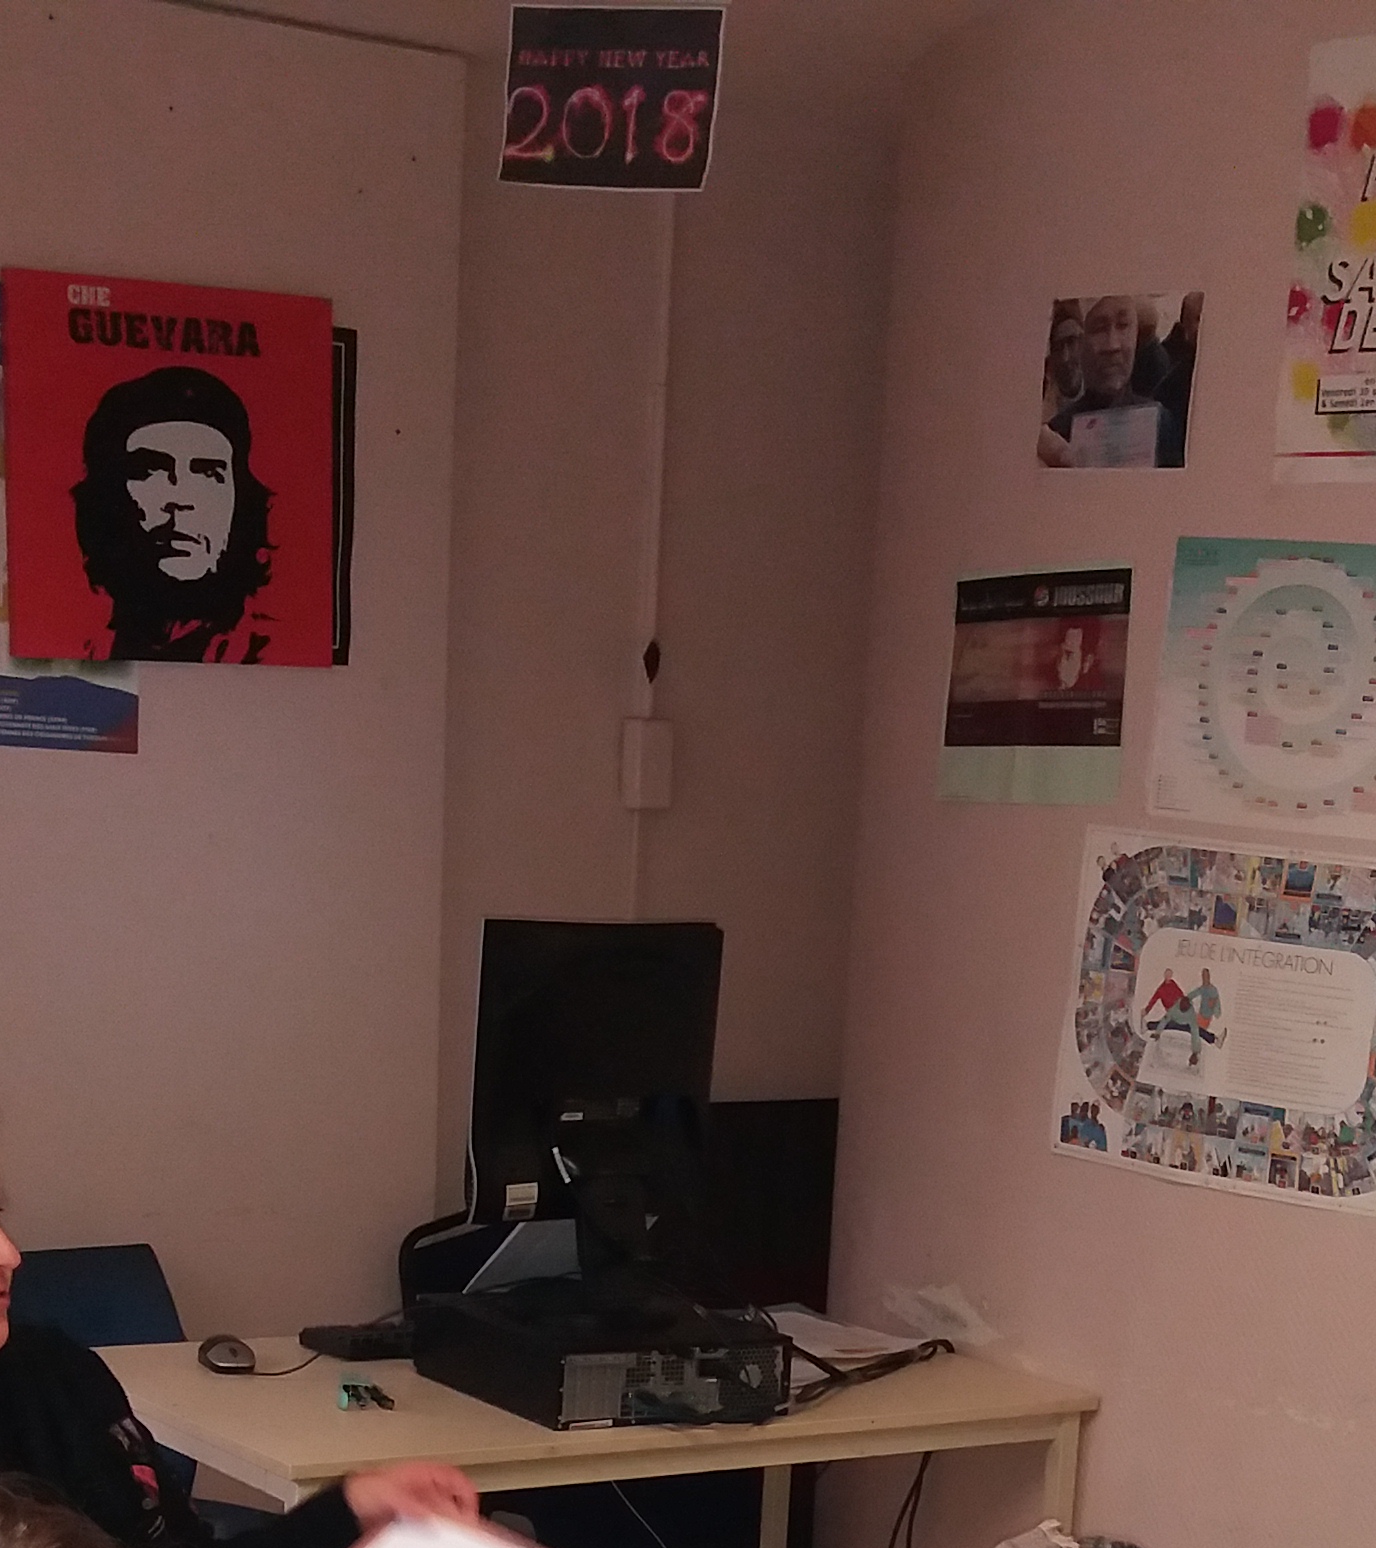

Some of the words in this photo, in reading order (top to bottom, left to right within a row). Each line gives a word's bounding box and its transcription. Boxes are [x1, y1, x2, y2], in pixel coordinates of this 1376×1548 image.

[598, 50, 647, 68] NEW
[656, 51, 710, 68] YEAR
[503, 84, 708, 164] 2018
[66, 283, 111, 308] CHE
[67, 307, 261, 358] GUEVARA
[1174, 938, 1198, 959] JEU
[1199, 941, 1217, 961] DE
